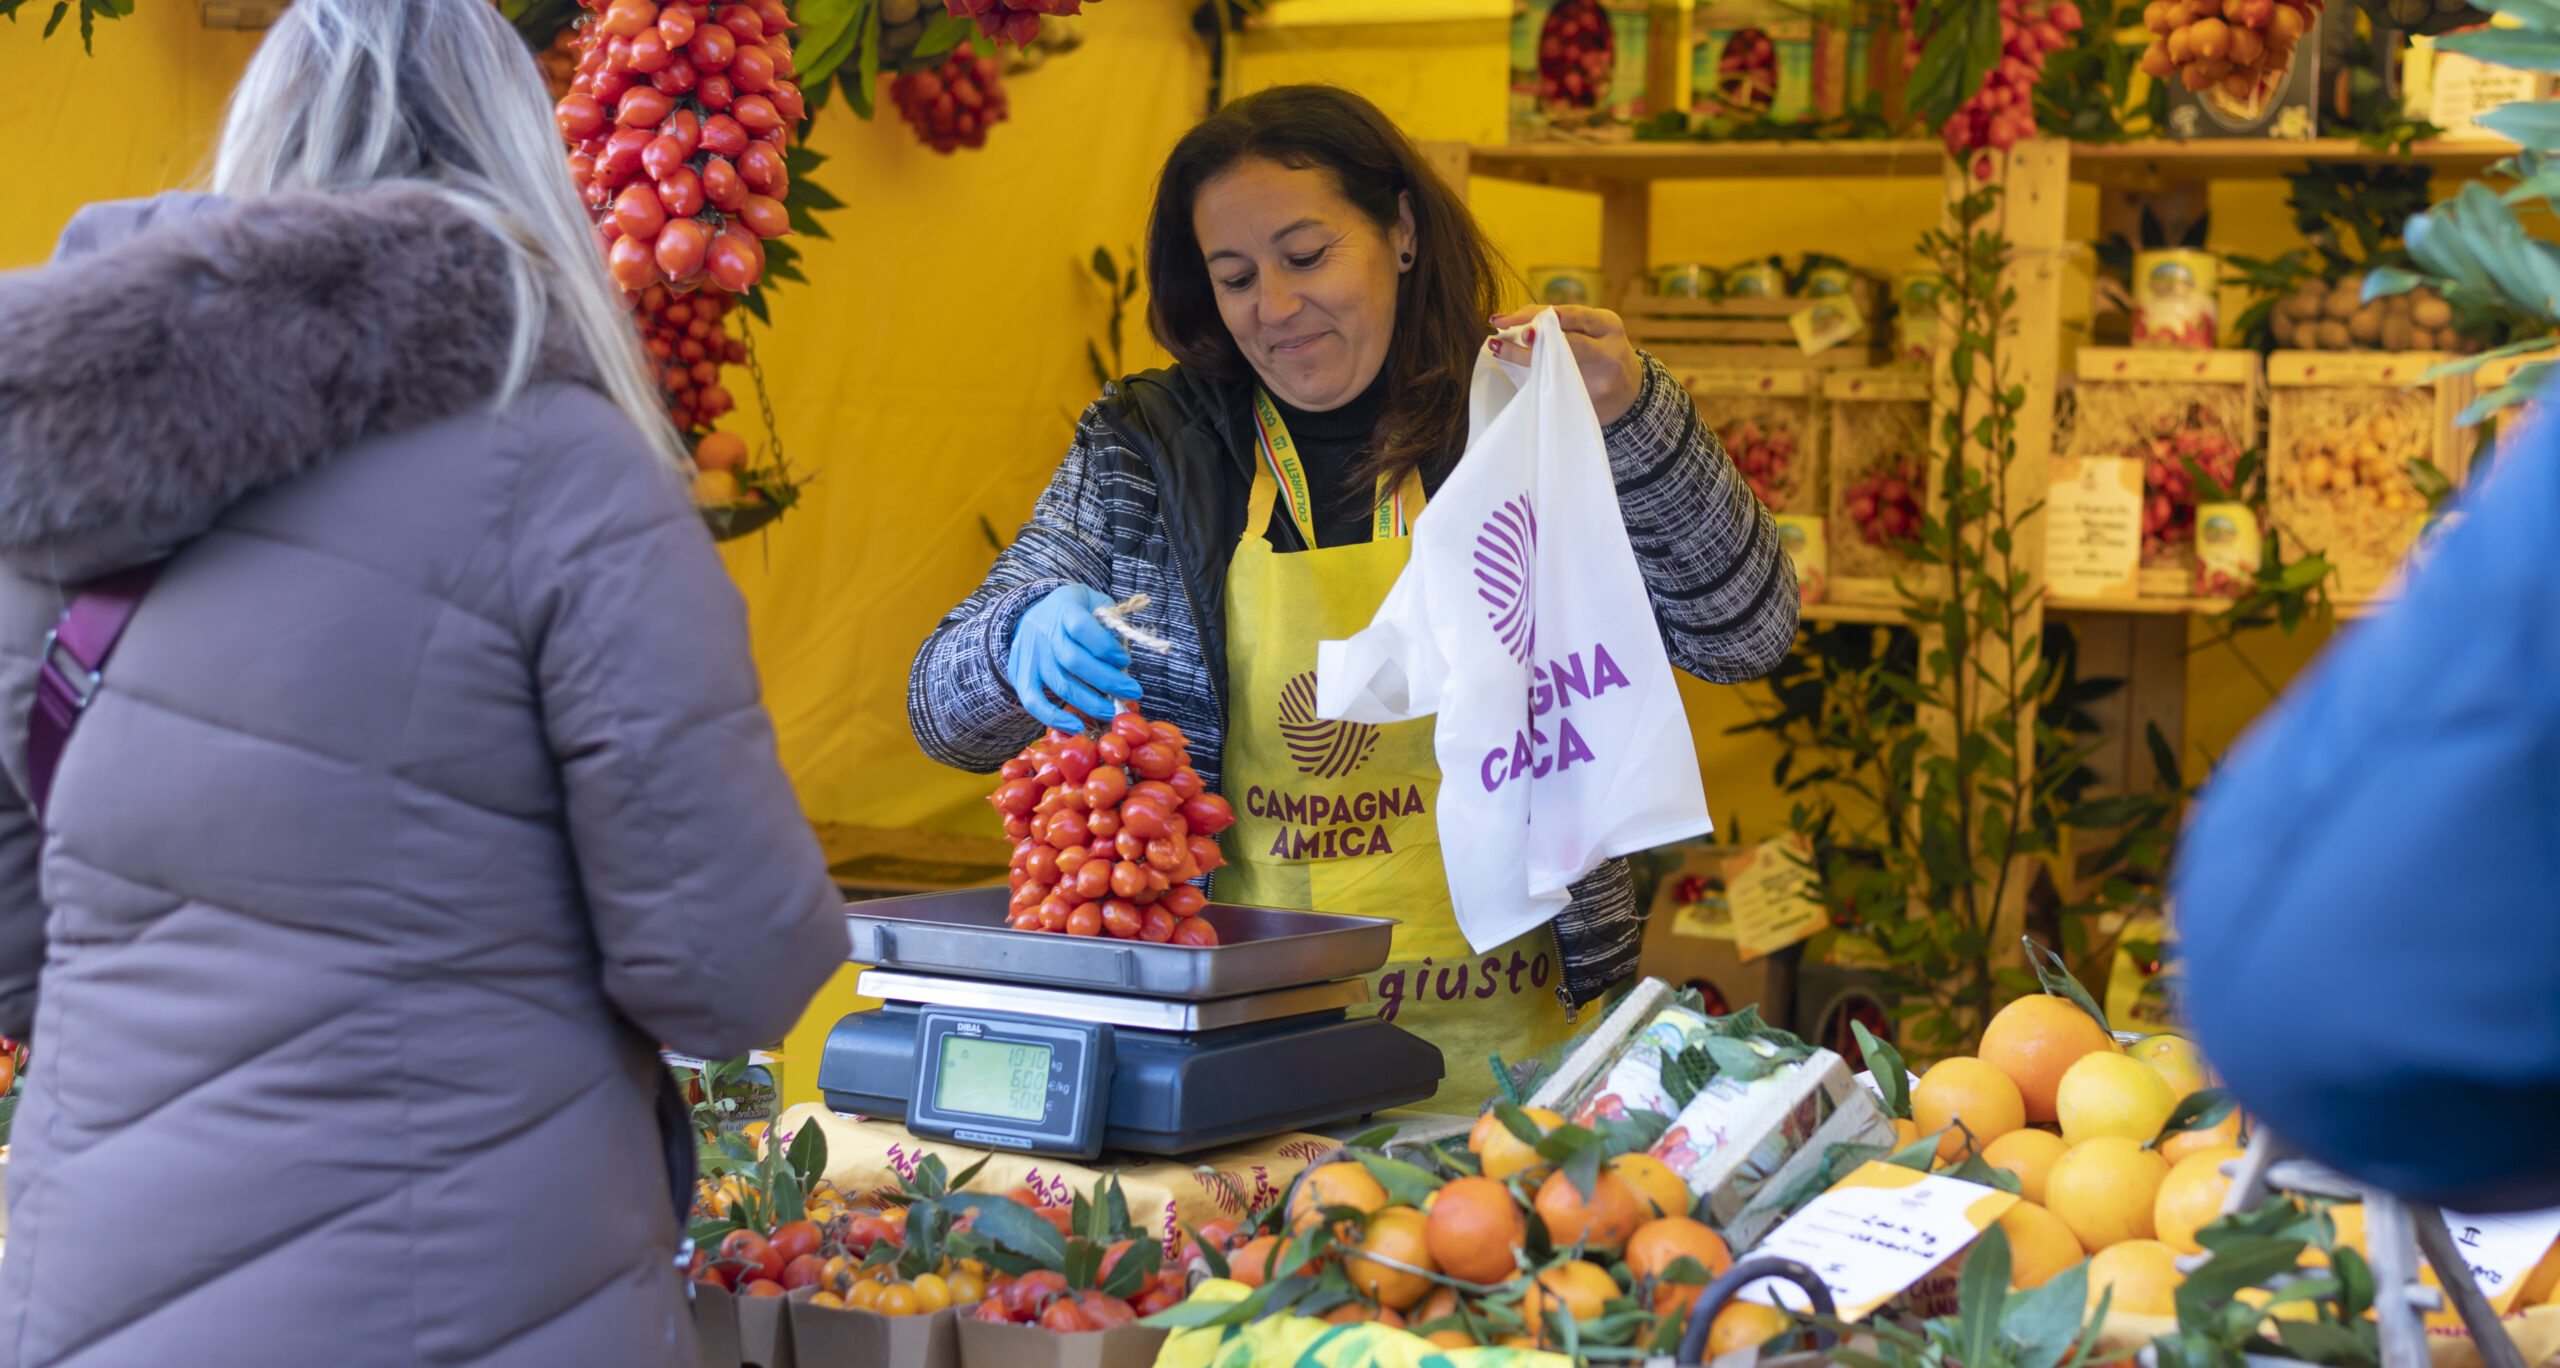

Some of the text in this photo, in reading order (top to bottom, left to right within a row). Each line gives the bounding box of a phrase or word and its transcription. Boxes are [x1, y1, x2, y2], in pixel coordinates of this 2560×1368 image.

[1282, 457, 1309, 523] COLDIRETTI
[1247, 784, 1425, 826] CAMPAGNA
[1270, 824, 1393, 859] AMICA
[1377, 950, 1549, 1022] giusto
[956, 1022, 982, 1033] DIBAL
[1052, 1059, 1063, 1073] kg
[1048, 1080, 1070, 1095] €/kg
